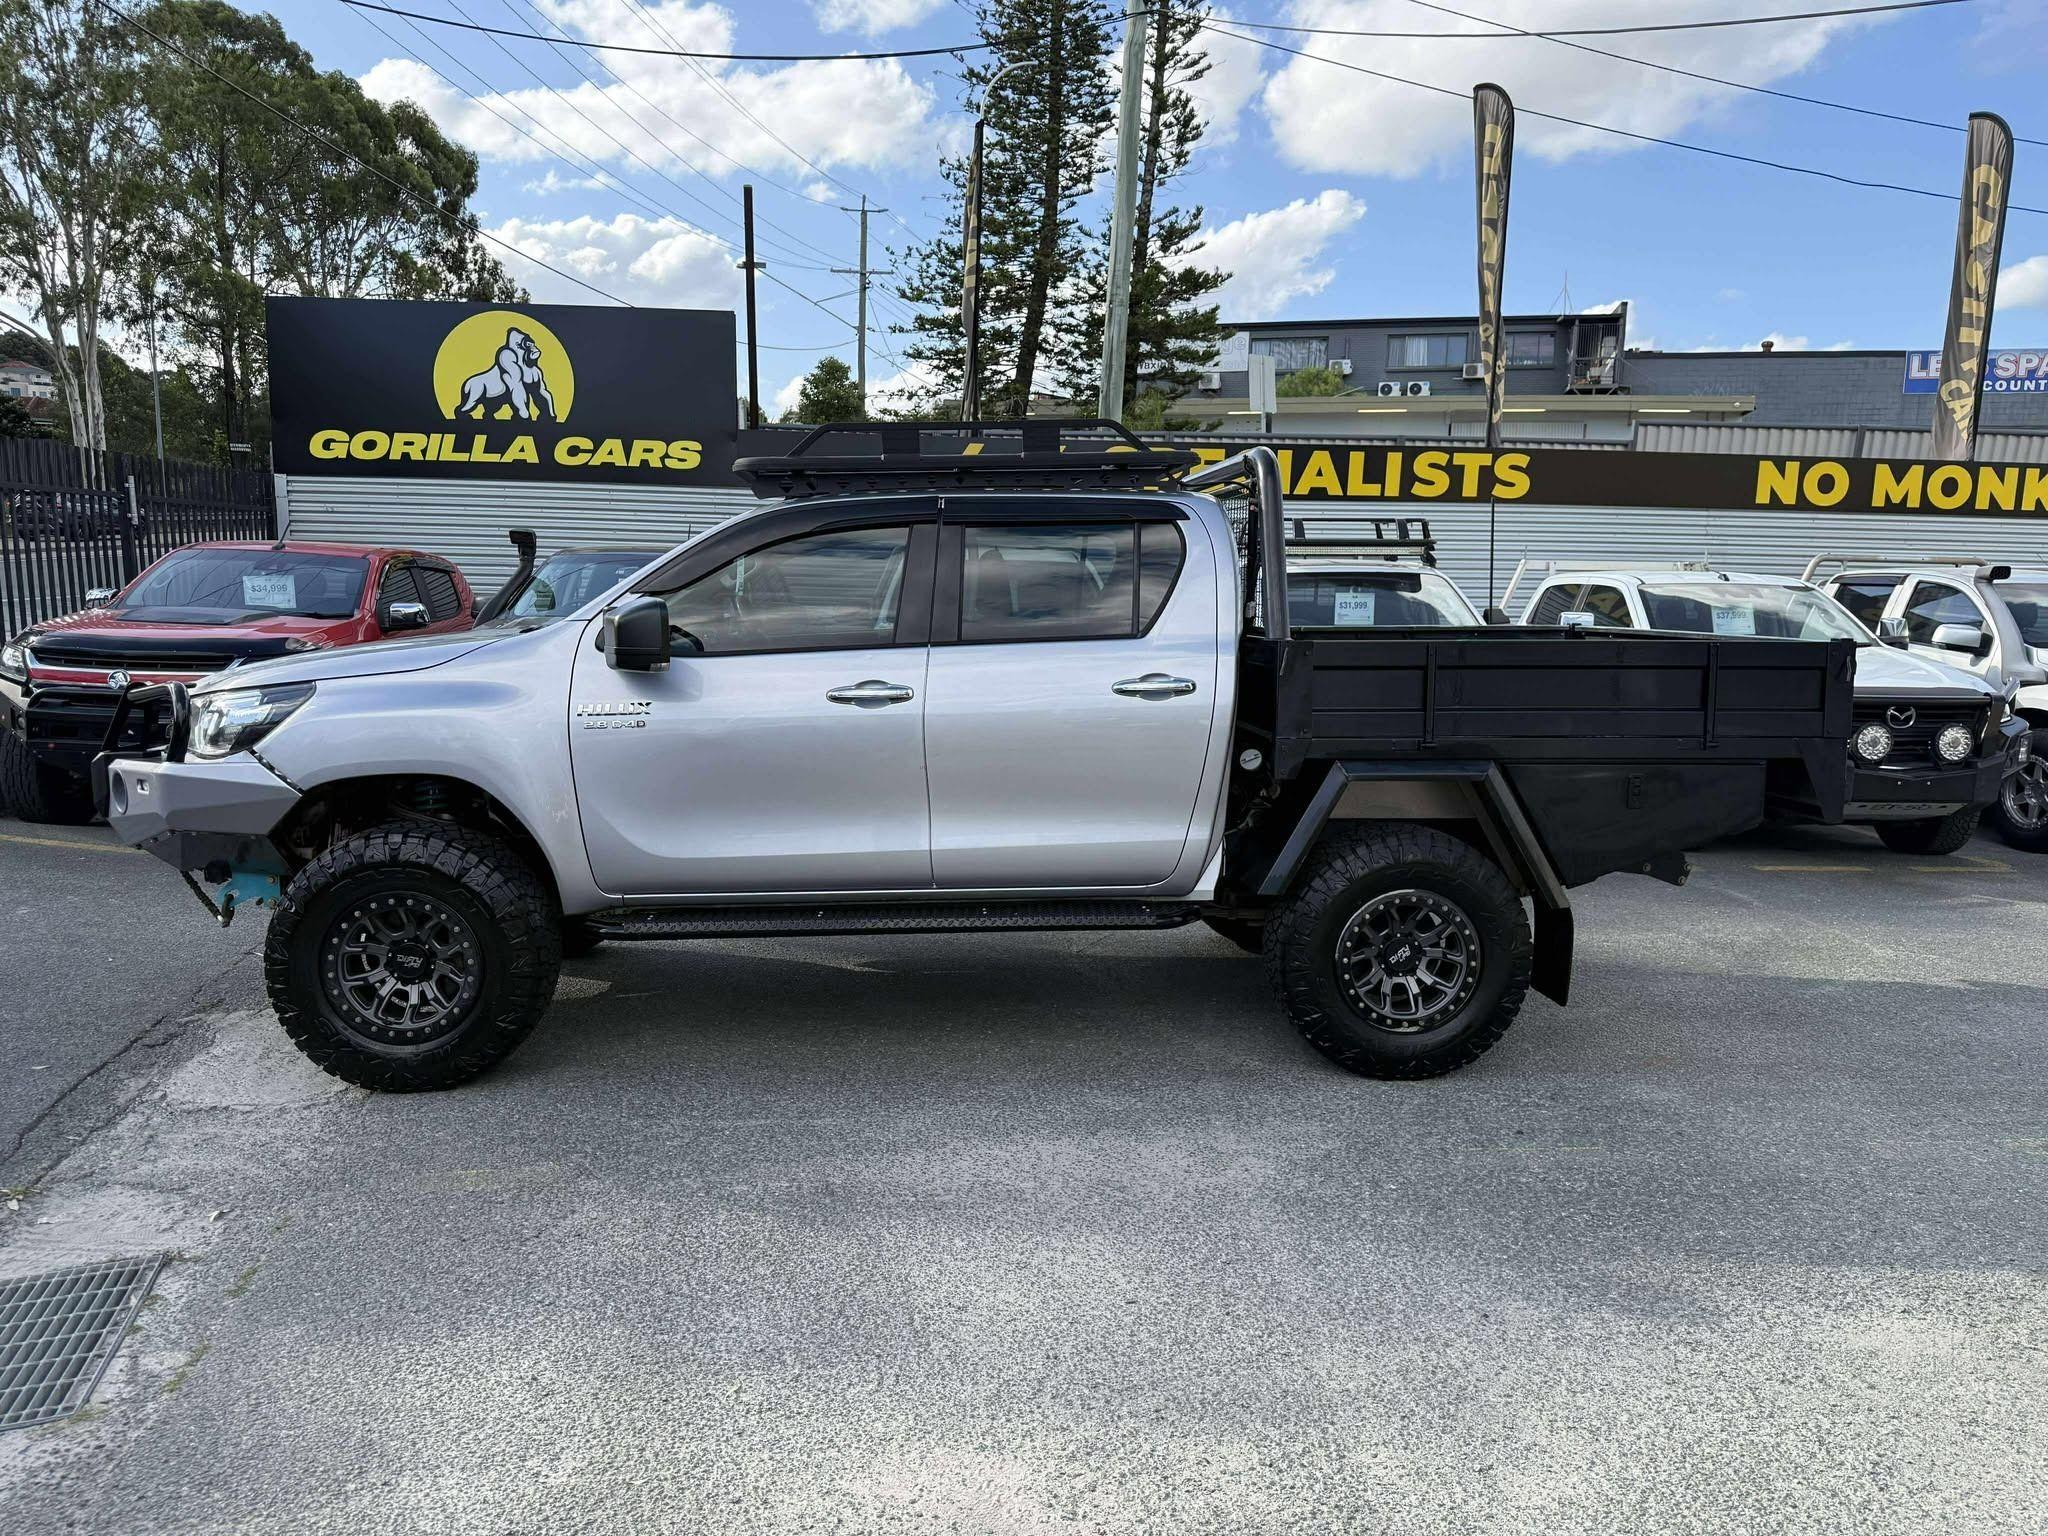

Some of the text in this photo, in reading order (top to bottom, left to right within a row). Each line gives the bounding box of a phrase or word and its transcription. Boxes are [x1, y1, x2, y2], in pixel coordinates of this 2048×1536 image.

[309, 430, 702, 470] GORILLA CARS
[1755, 460, 2048, 512] NO MONK
[1338, 601, 1368, 611] $31,999
[577, 702, 652, 716] HILUX
